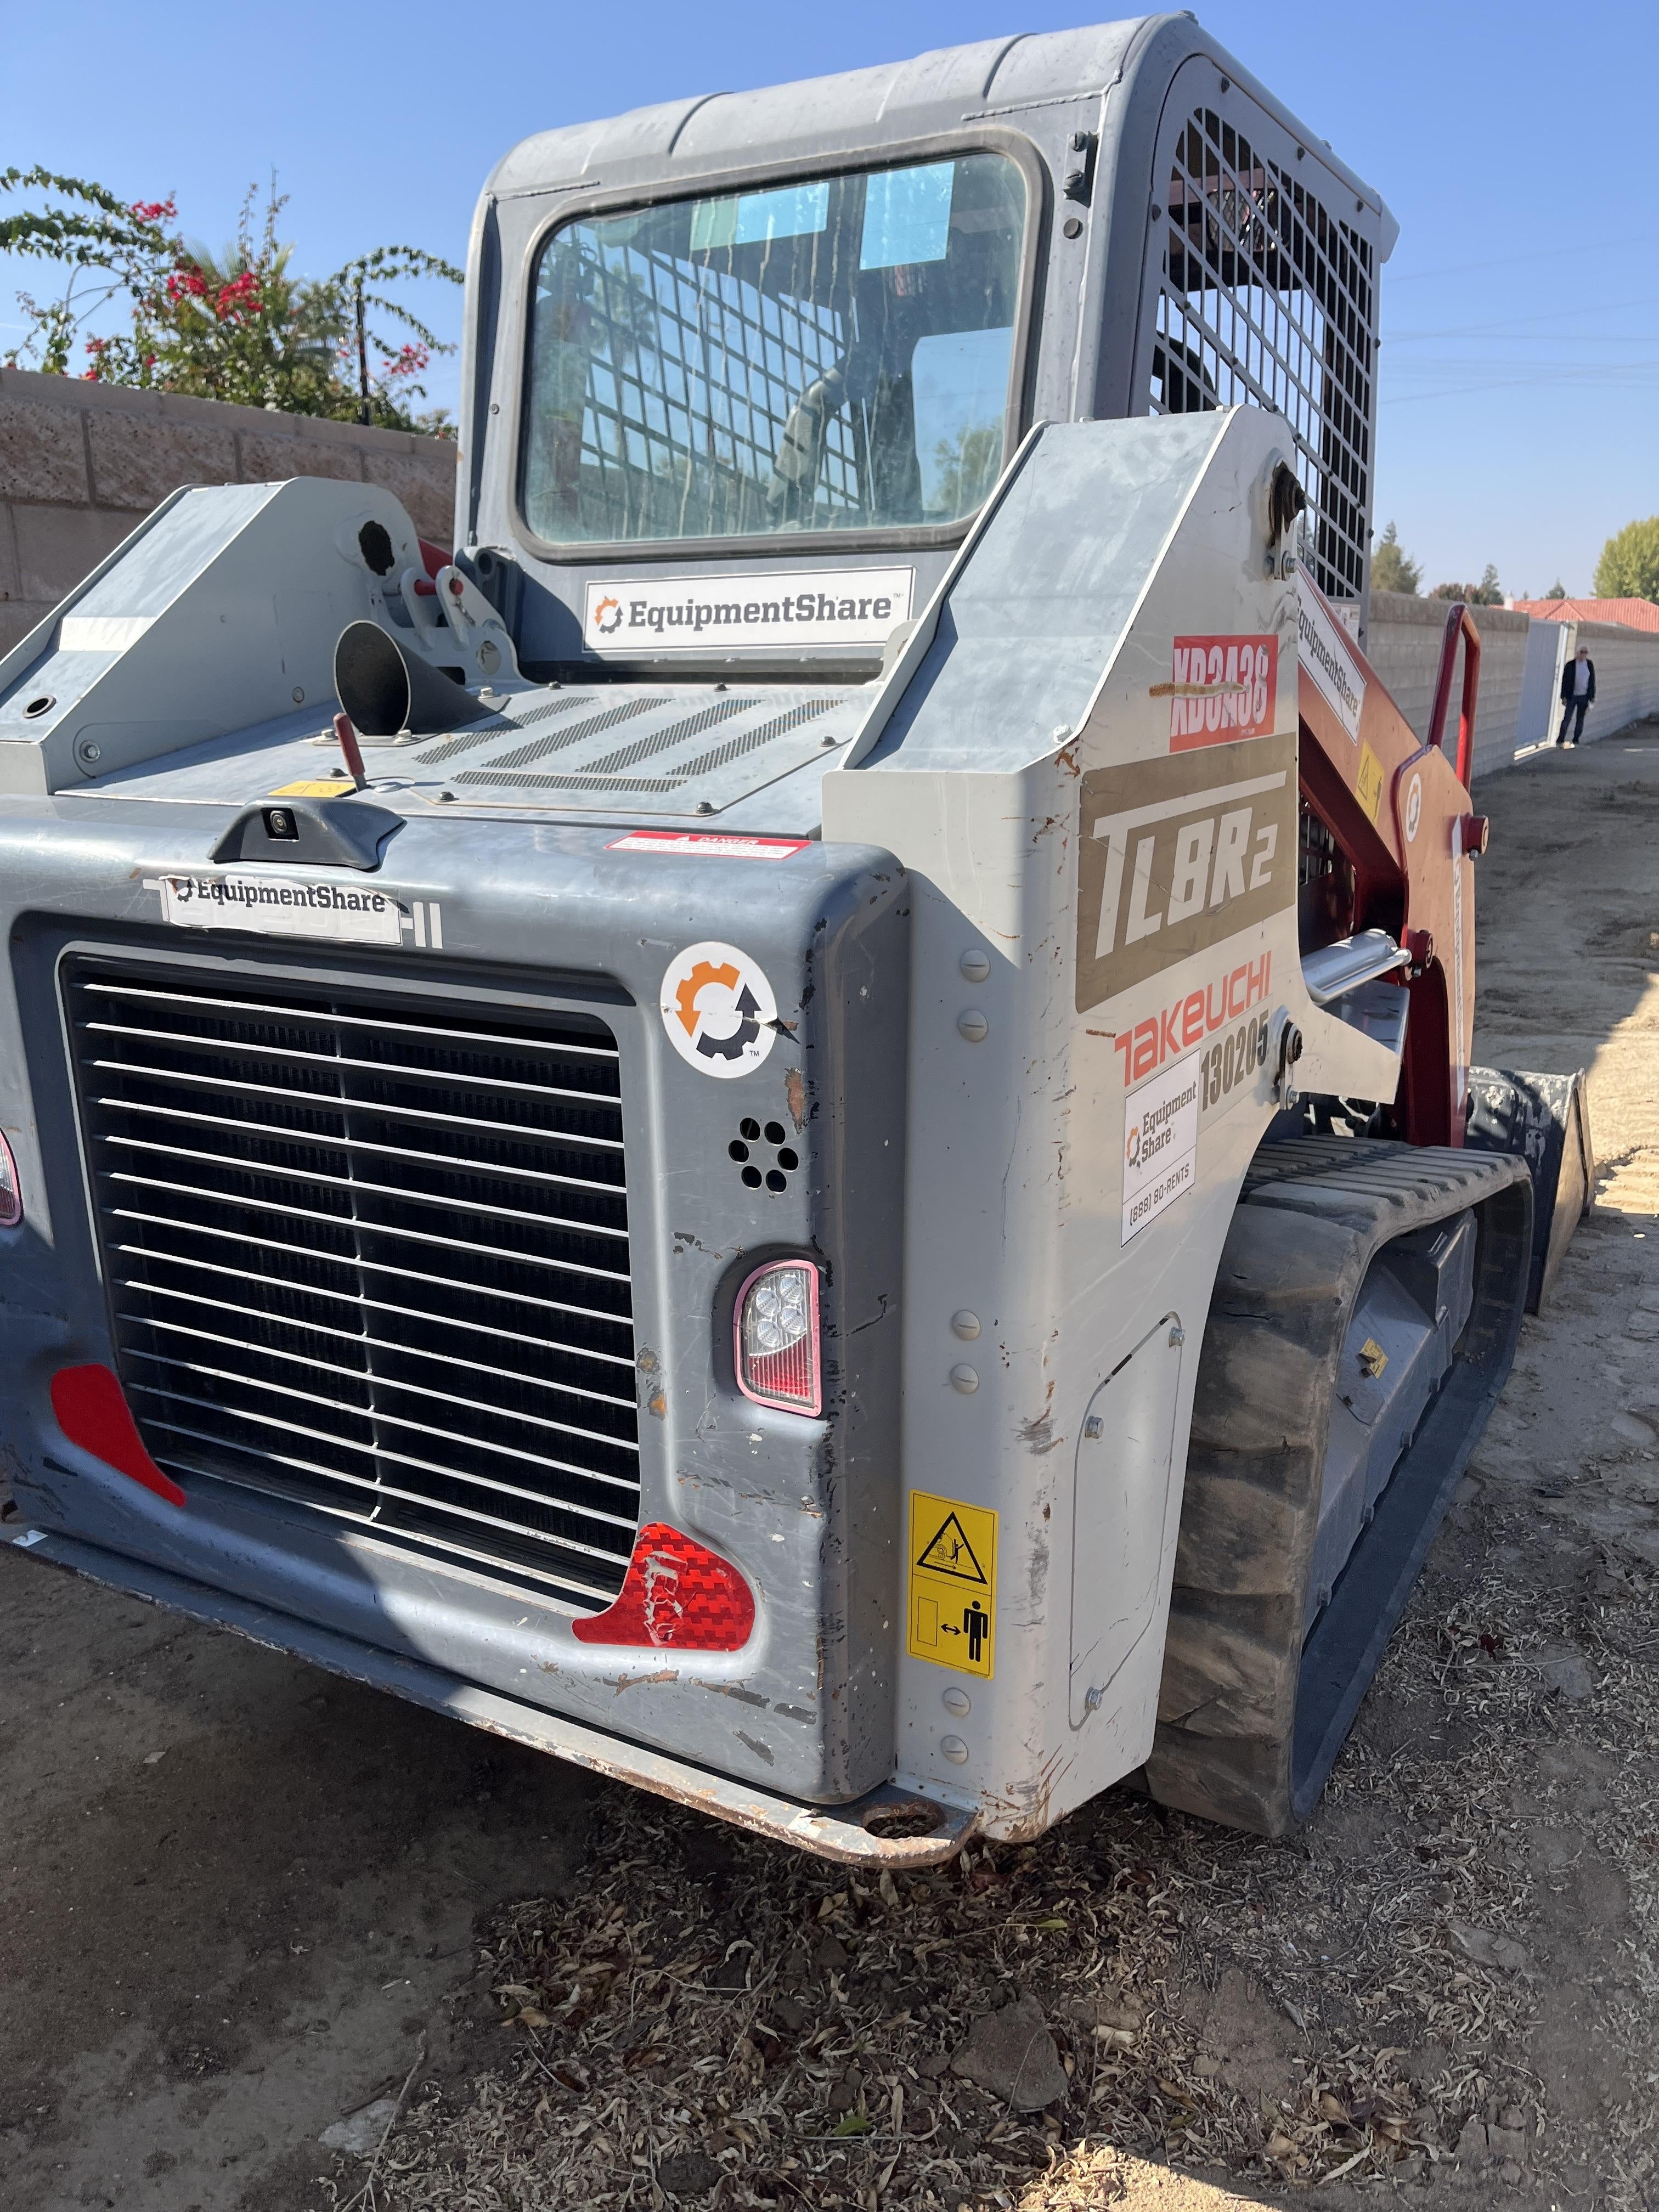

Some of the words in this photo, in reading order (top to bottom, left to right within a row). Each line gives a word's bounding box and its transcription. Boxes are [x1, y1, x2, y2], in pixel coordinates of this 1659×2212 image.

[629, 593, 891, 633] EquipmentShare
[697, 837, 759, 845] DANGER
[198, 880, 386, 912] EquipmentShare
[1201, 1009, 1269, 1111] 130205
[1143, 1080, 1197, 1135] Equipment
[1142, 1127, 1171, 1163] Share
[1130, 1193, 1152, 1226] (888)
